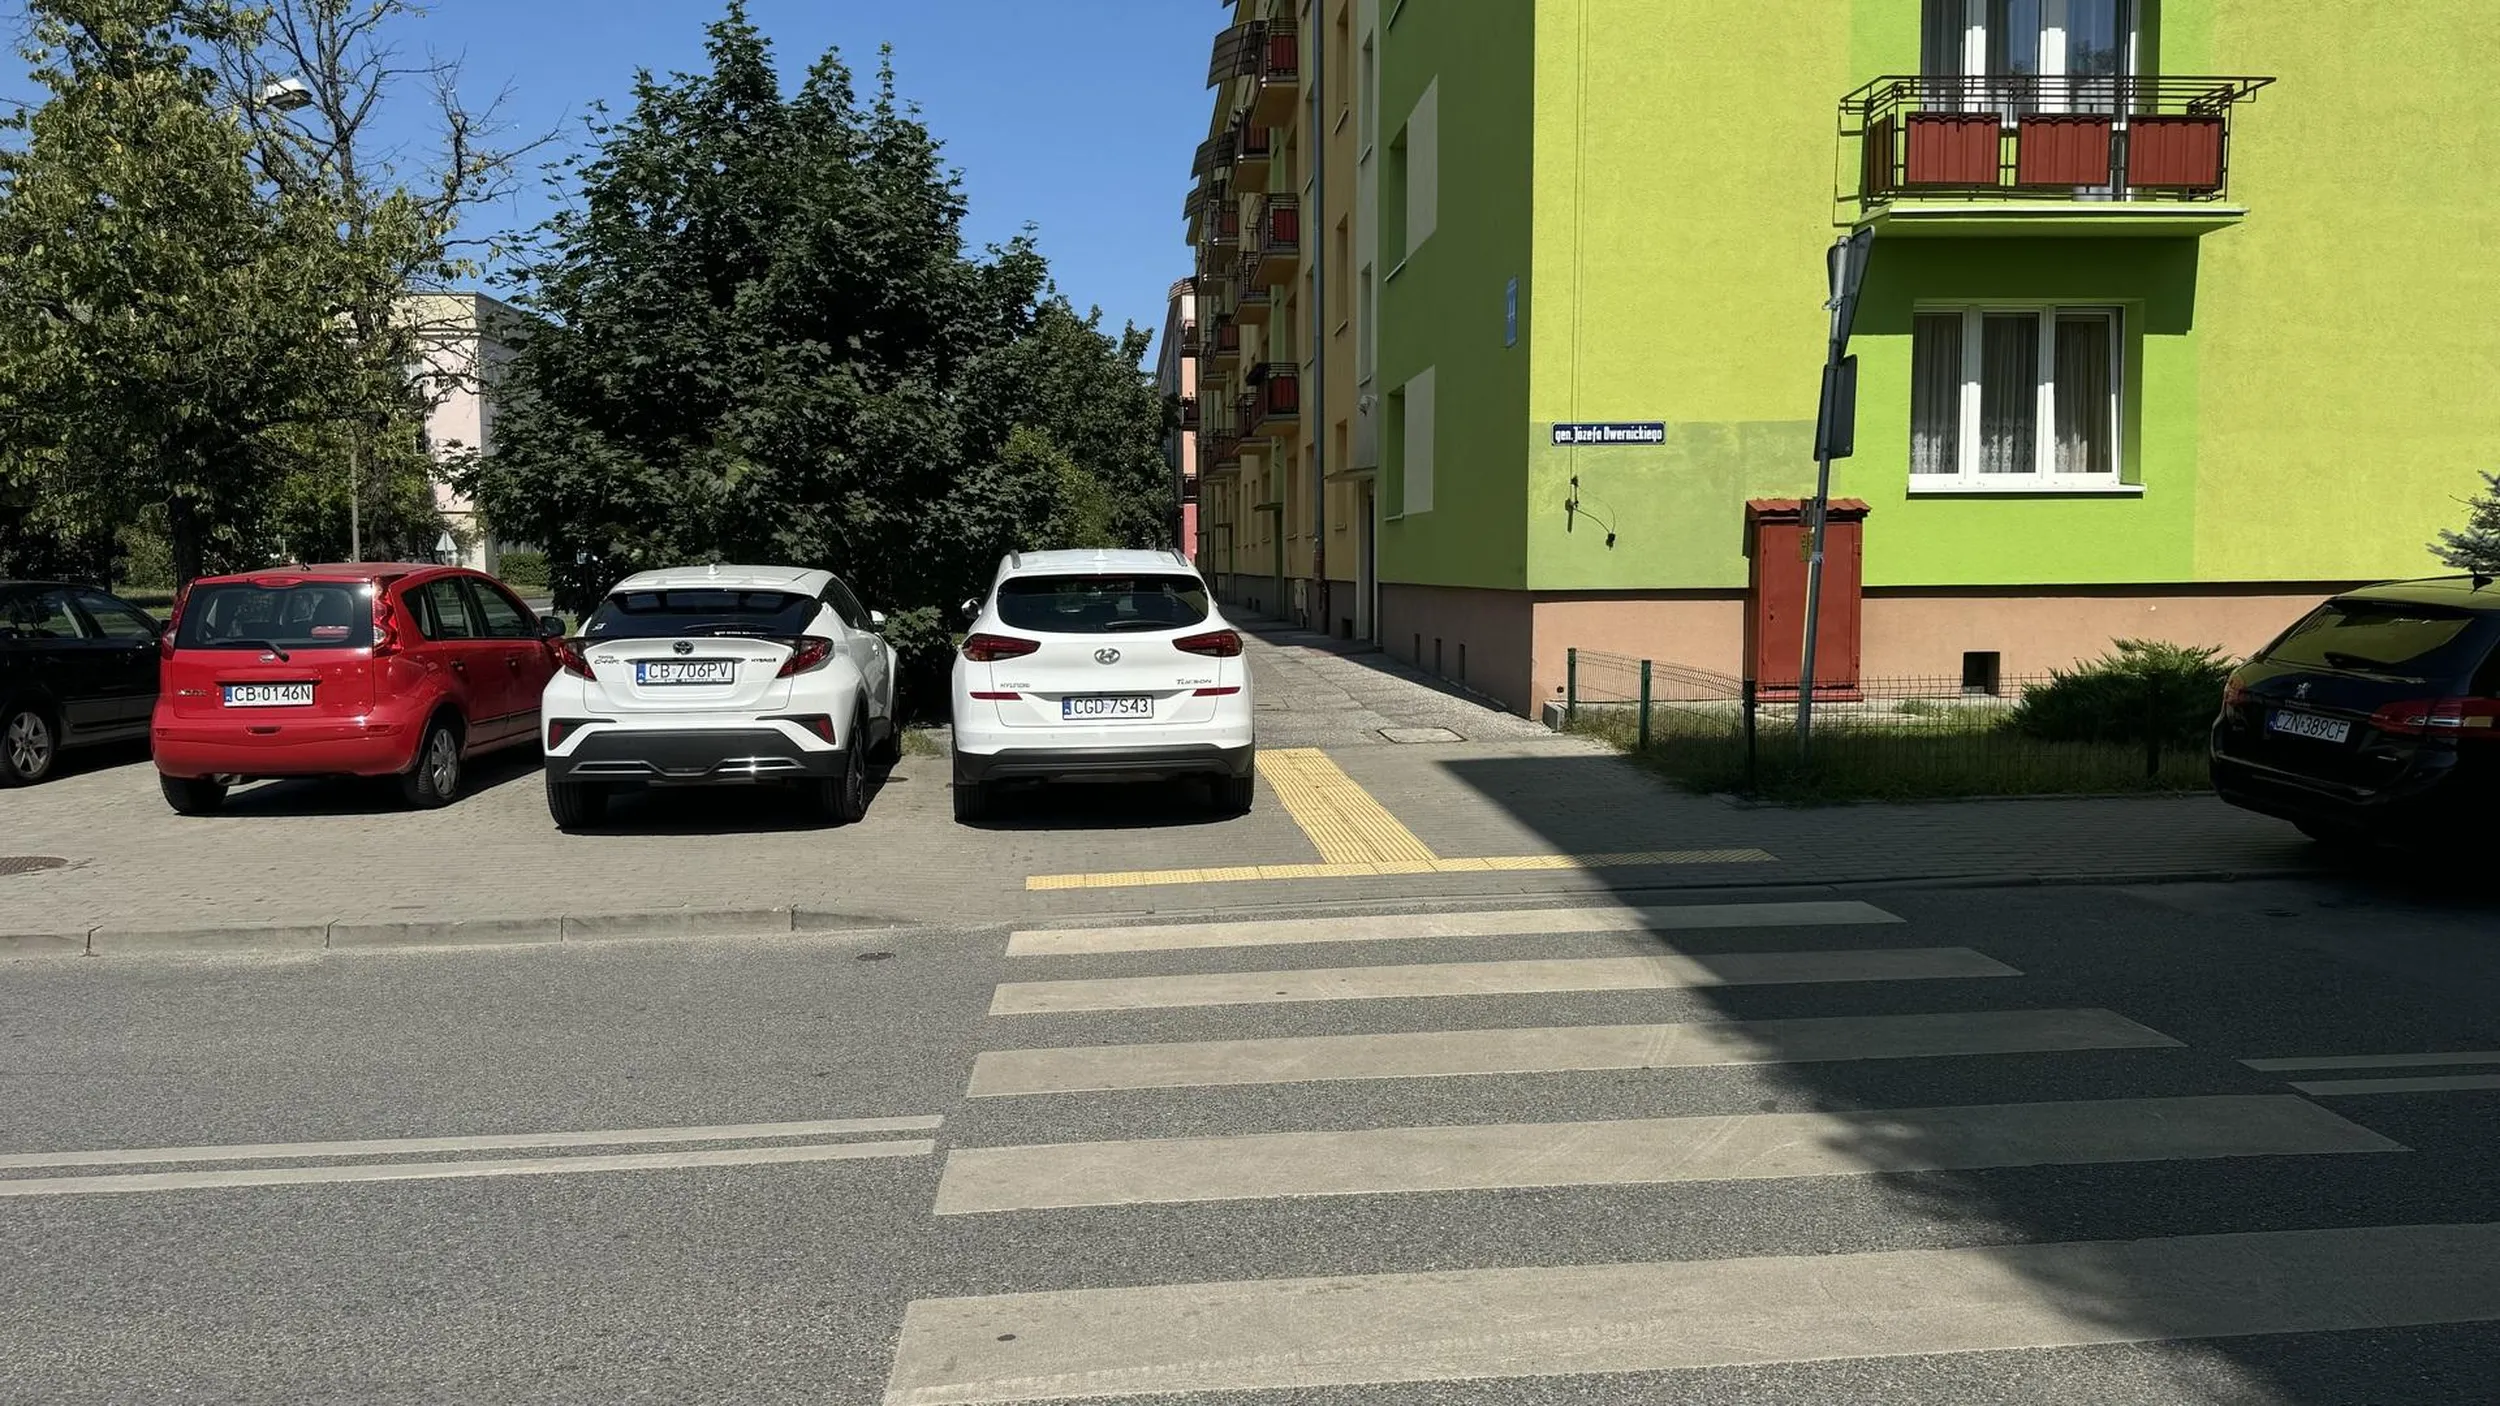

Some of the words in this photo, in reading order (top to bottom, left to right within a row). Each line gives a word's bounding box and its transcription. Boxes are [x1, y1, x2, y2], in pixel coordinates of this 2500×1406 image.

[1555, 430, 1573, 443] gen.
[1573, 425, 1601, 443] Józefa
[1603, 425, 1663, 443] Dwernickiego
[649, 663, 670, 678] CB
[677, 662, 728, 678] 706PV
[234, 687, 256, 701] CB
[262, 686, 311, 701] 0146N
[1074, 699, 1104, 714] CGD
[1110, 698, 1148, 714] 7S43
[2275, 712, 2301, 732] CZN
[2303, 717, 2348, 740] 389CF
